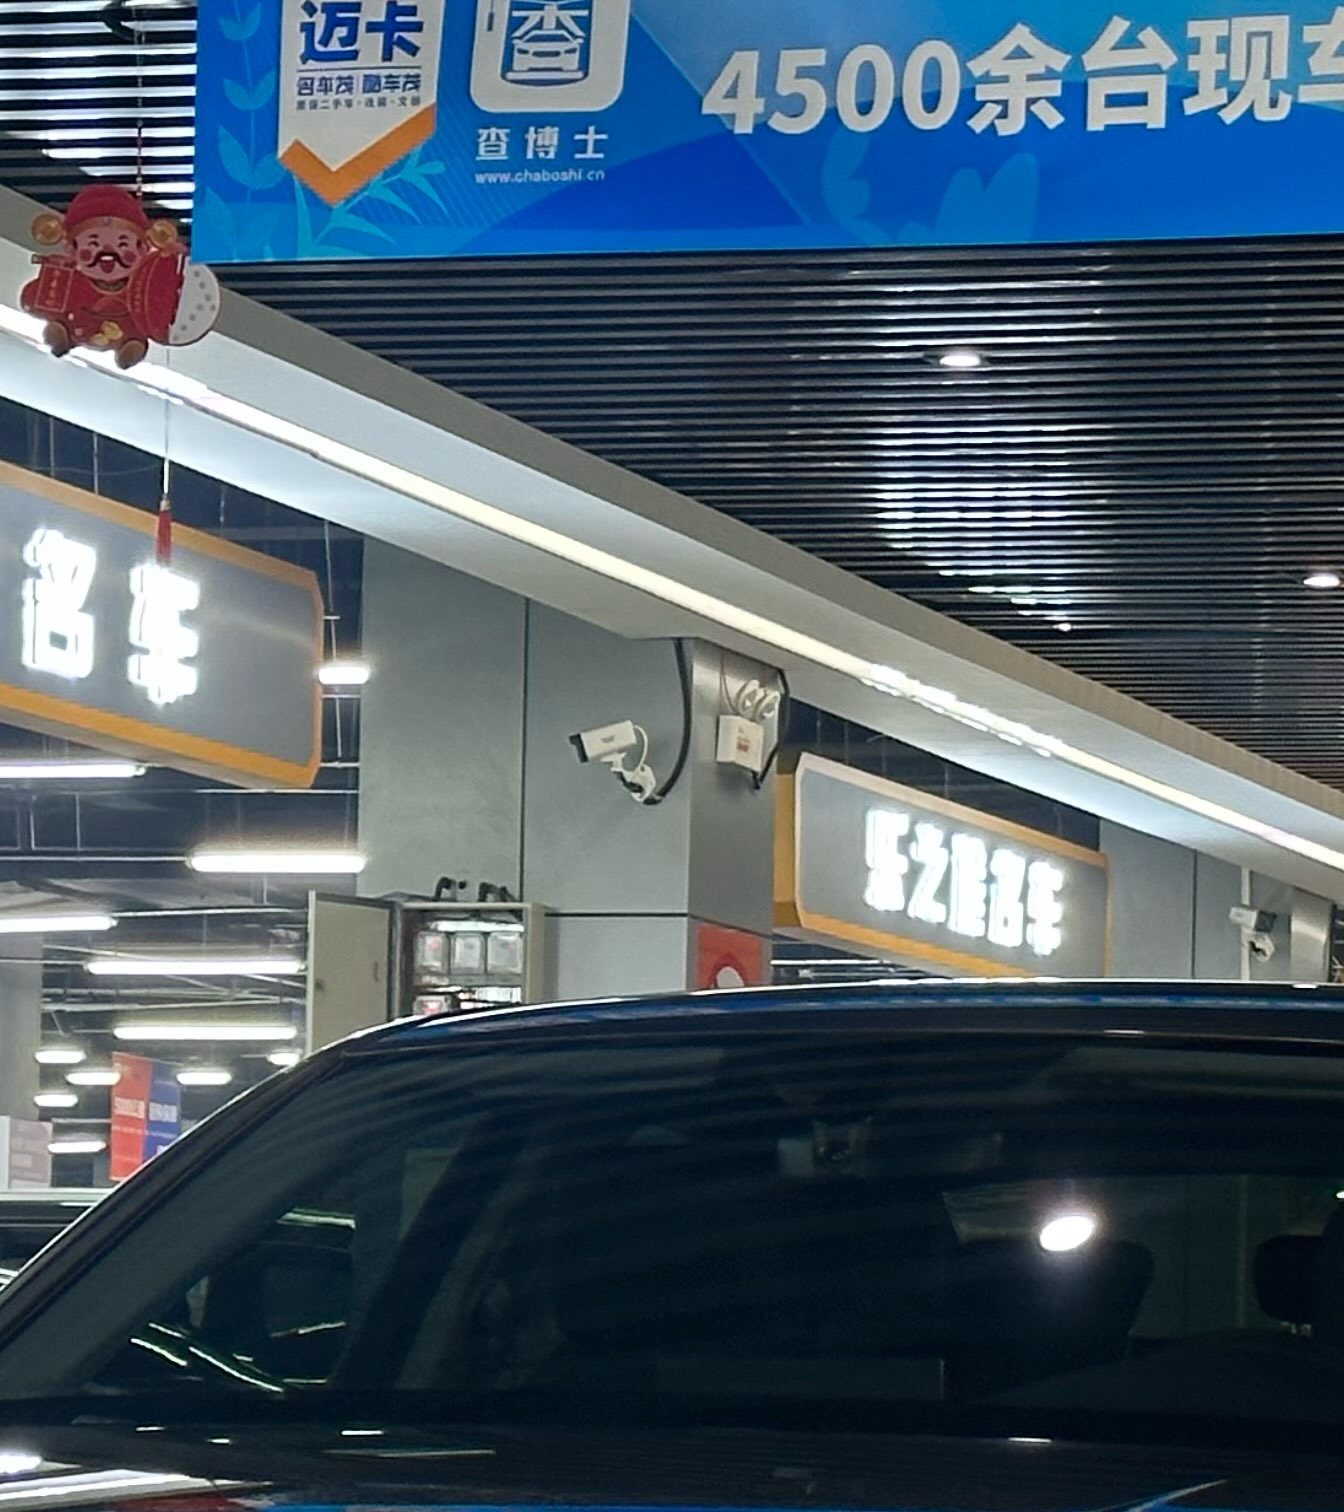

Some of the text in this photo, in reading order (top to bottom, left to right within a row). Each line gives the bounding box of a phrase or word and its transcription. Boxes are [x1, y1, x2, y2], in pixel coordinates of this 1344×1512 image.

[476, 125, 609, 161] 查博士
[475, 168, 605, 184] www.chaboshi.cn
